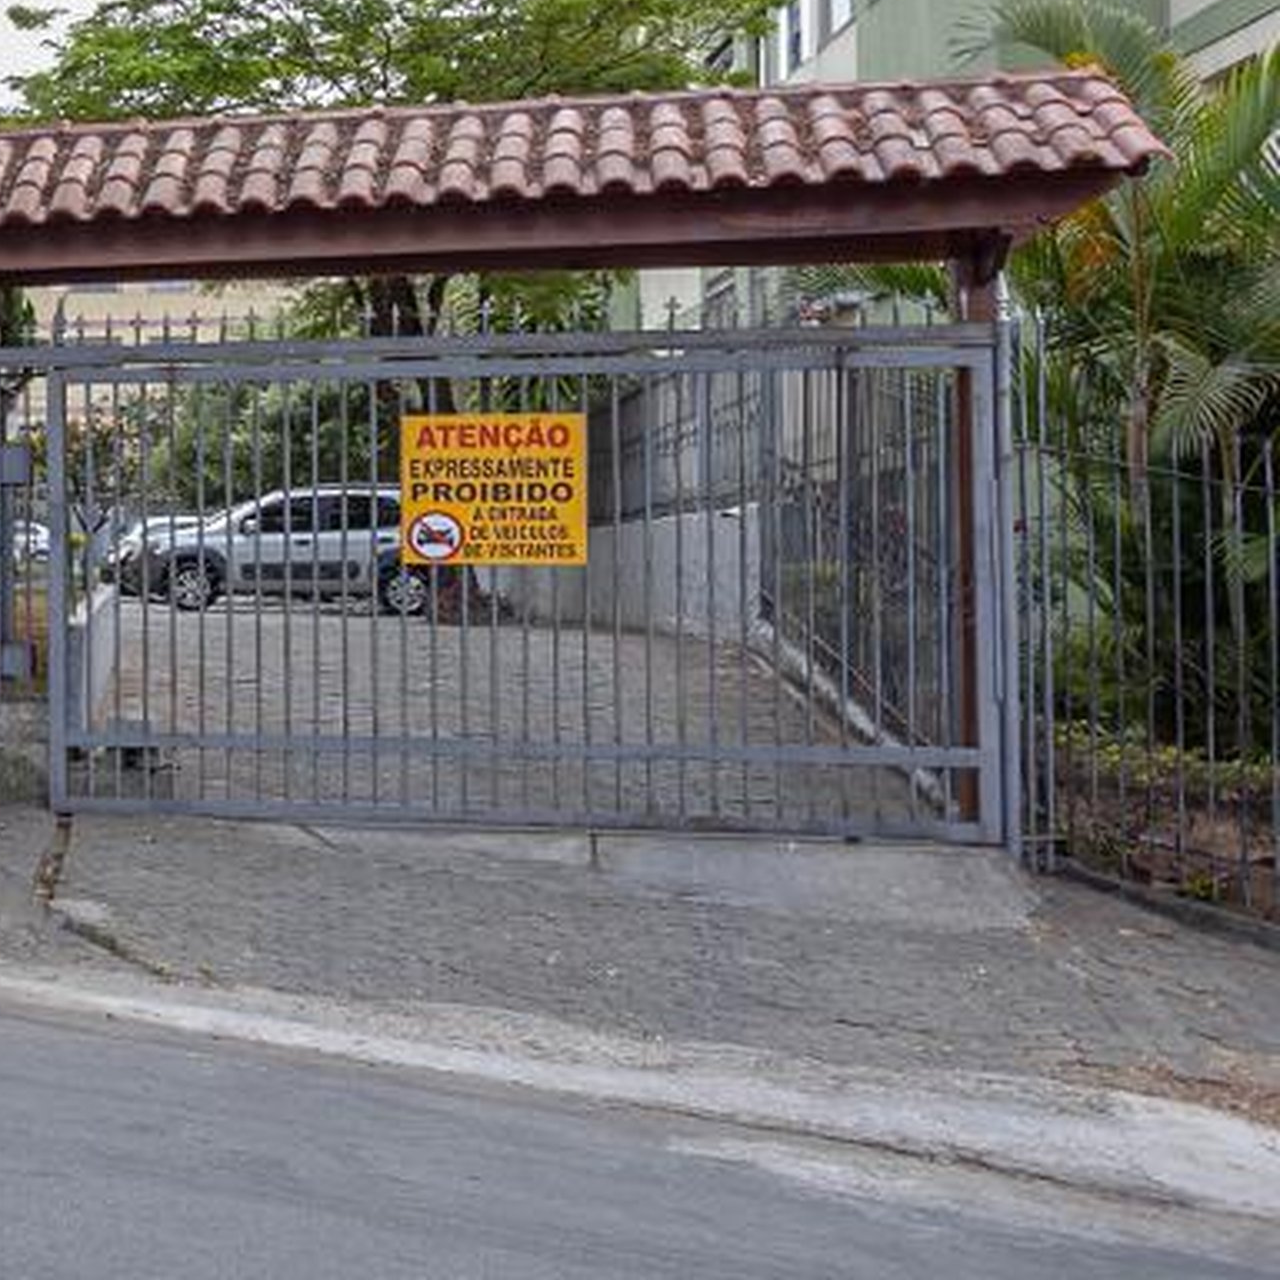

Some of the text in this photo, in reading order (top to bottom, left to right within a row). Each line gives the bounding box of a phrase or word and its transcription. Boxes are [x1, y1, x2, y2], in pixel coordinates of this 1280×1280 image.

[417, 419, 571, 452] ATENÇÃO
[410, 458, 575, 478] EXPRESSAMENTE
[412, 482, 573, 503] PROIBIDO
[490, 507, 558, 521] ENTRADA
[488, 543, 577, 558] VISITANTES
